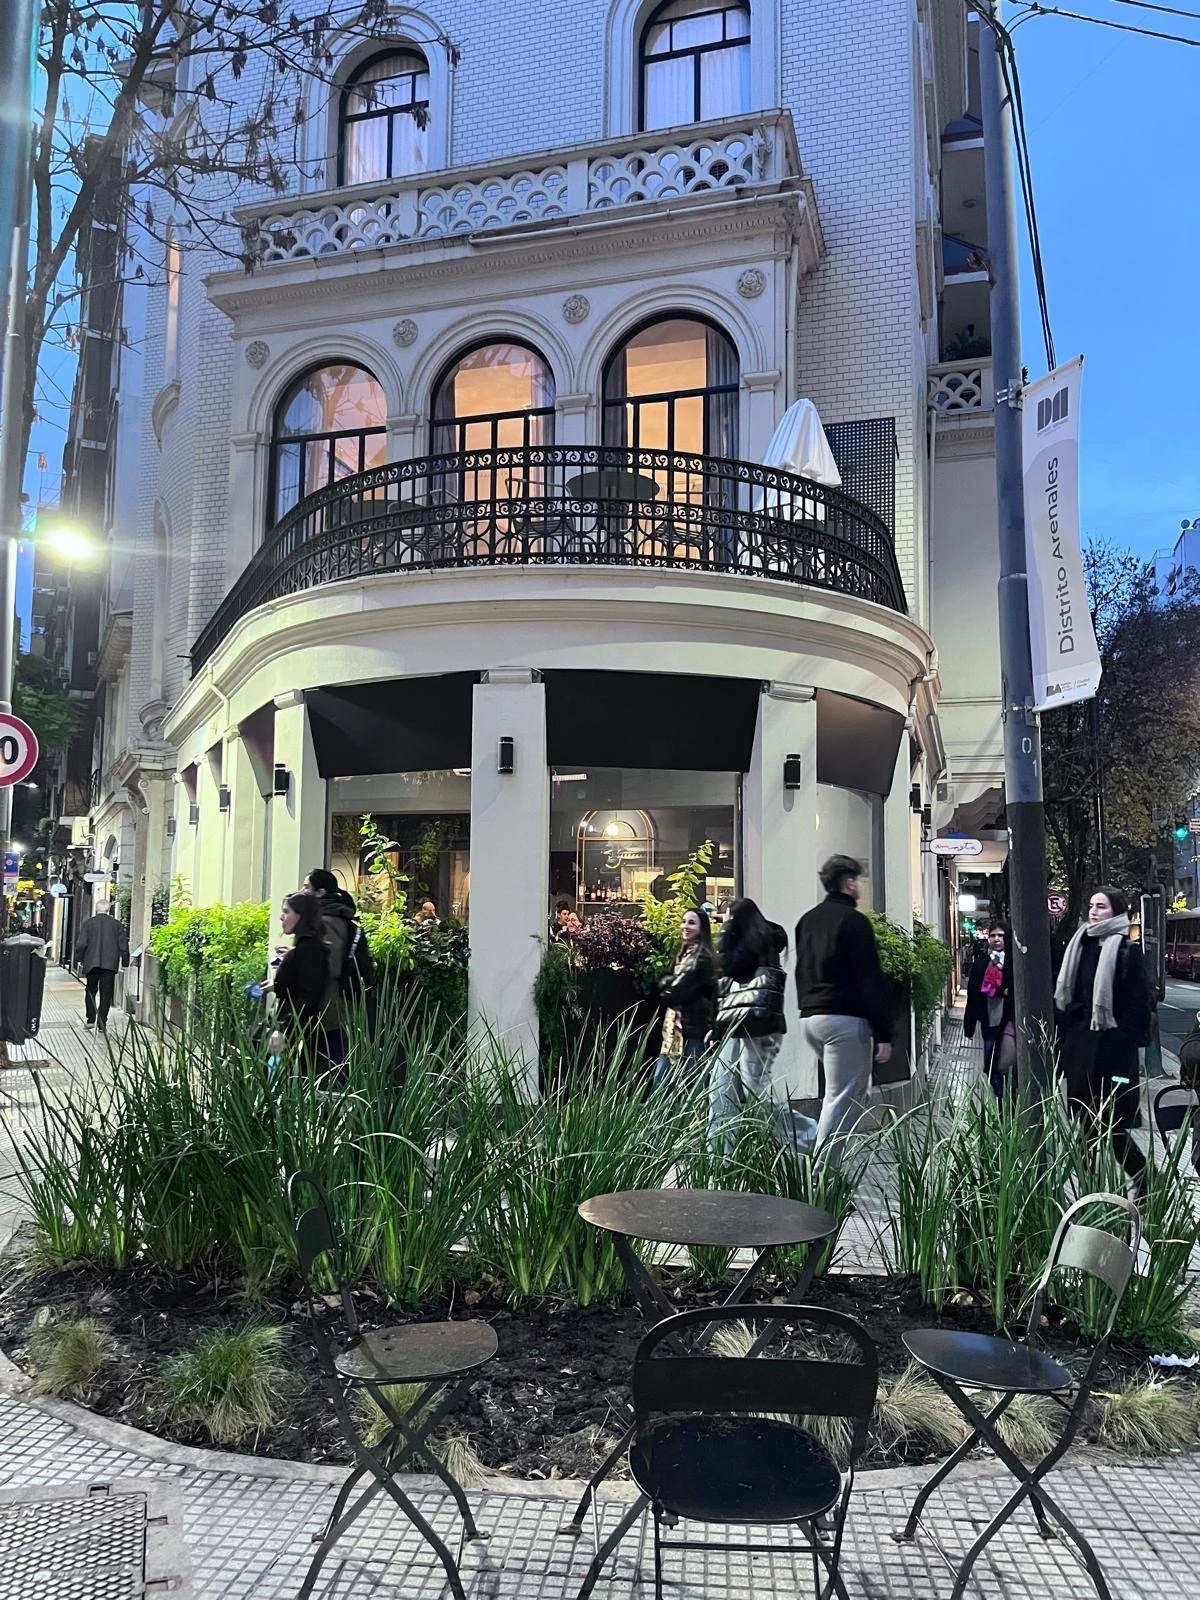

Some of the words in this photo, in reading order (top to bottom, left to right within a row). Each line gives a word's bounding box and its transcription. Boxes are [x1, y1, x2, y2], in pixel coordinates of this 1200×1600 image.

[1045, 457, 1063, 559] Arenales
[1056, 566, 1075, 655] Distrito
[1046, 683, 1062, 697] BA
